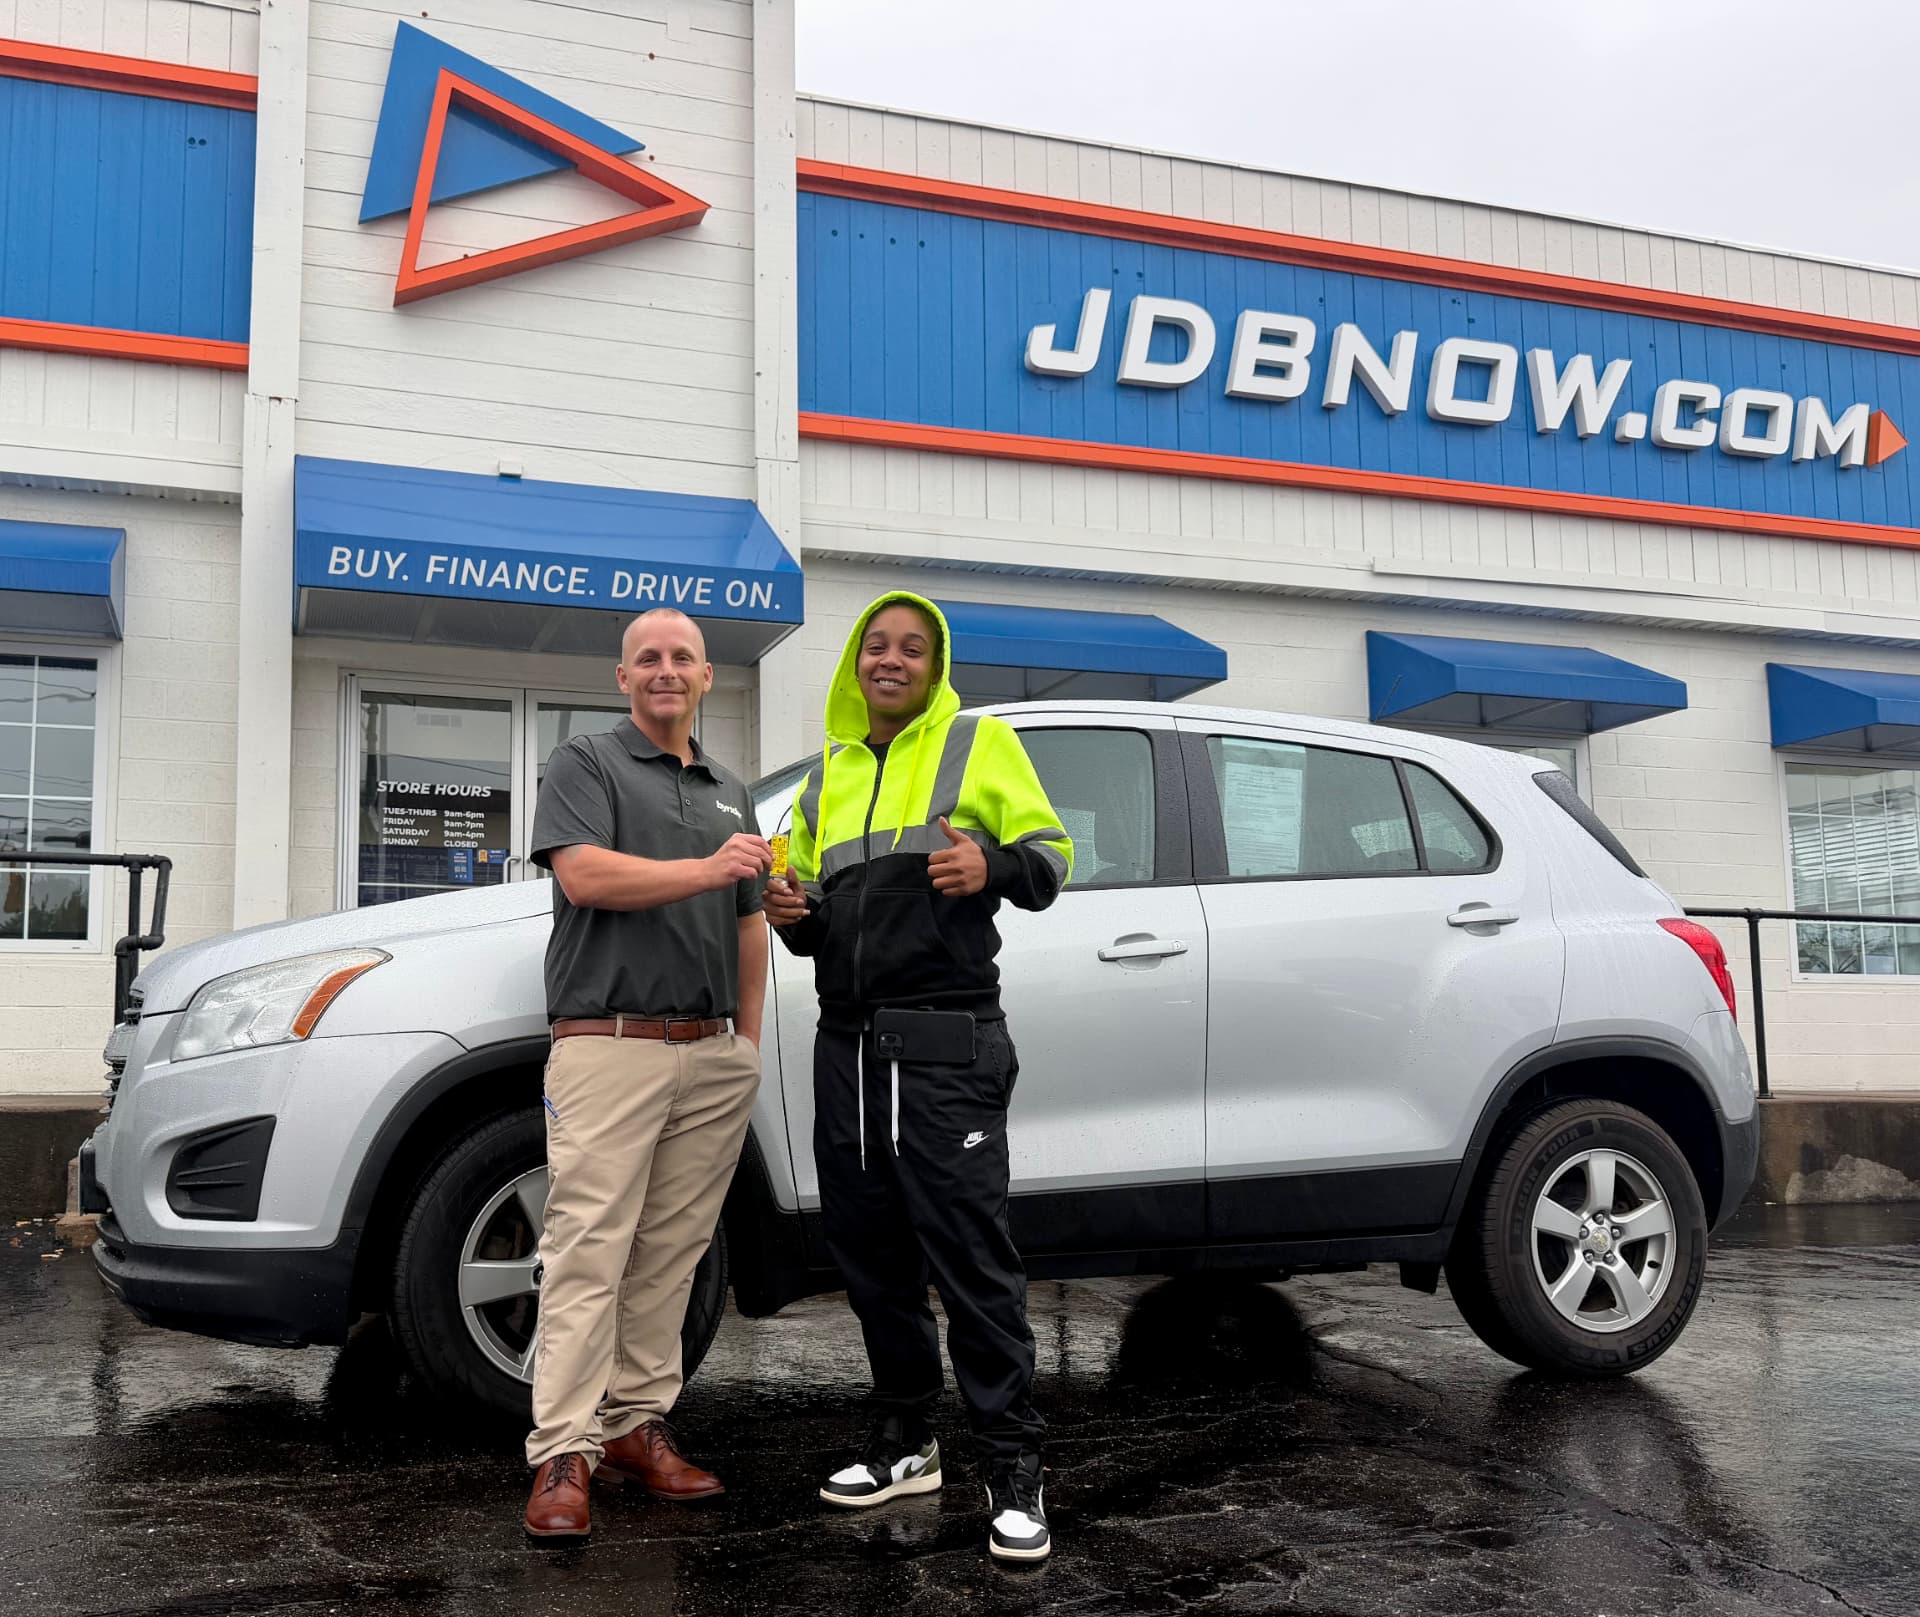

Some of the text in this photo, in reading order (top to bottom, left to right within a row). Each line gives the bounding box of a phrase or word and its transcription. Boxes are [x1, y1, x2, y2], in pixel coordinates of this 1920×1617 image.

[1025, 288, 1870, 468] JDBNOW.COM
[327, 545, 782, 610] BUY. FINANCE. DRIVE ON.
[377, 781, 492, 797] STORE HOURS
[383, 807, 484, 819] TUES-THURS 9am-6pm
[444, 820, 484, 829] 9am-7pm
[383, 828, 484, 839] SATURDAY 9am-4pm
[383, 838, 478, 848] SUNDAY CLOSED
